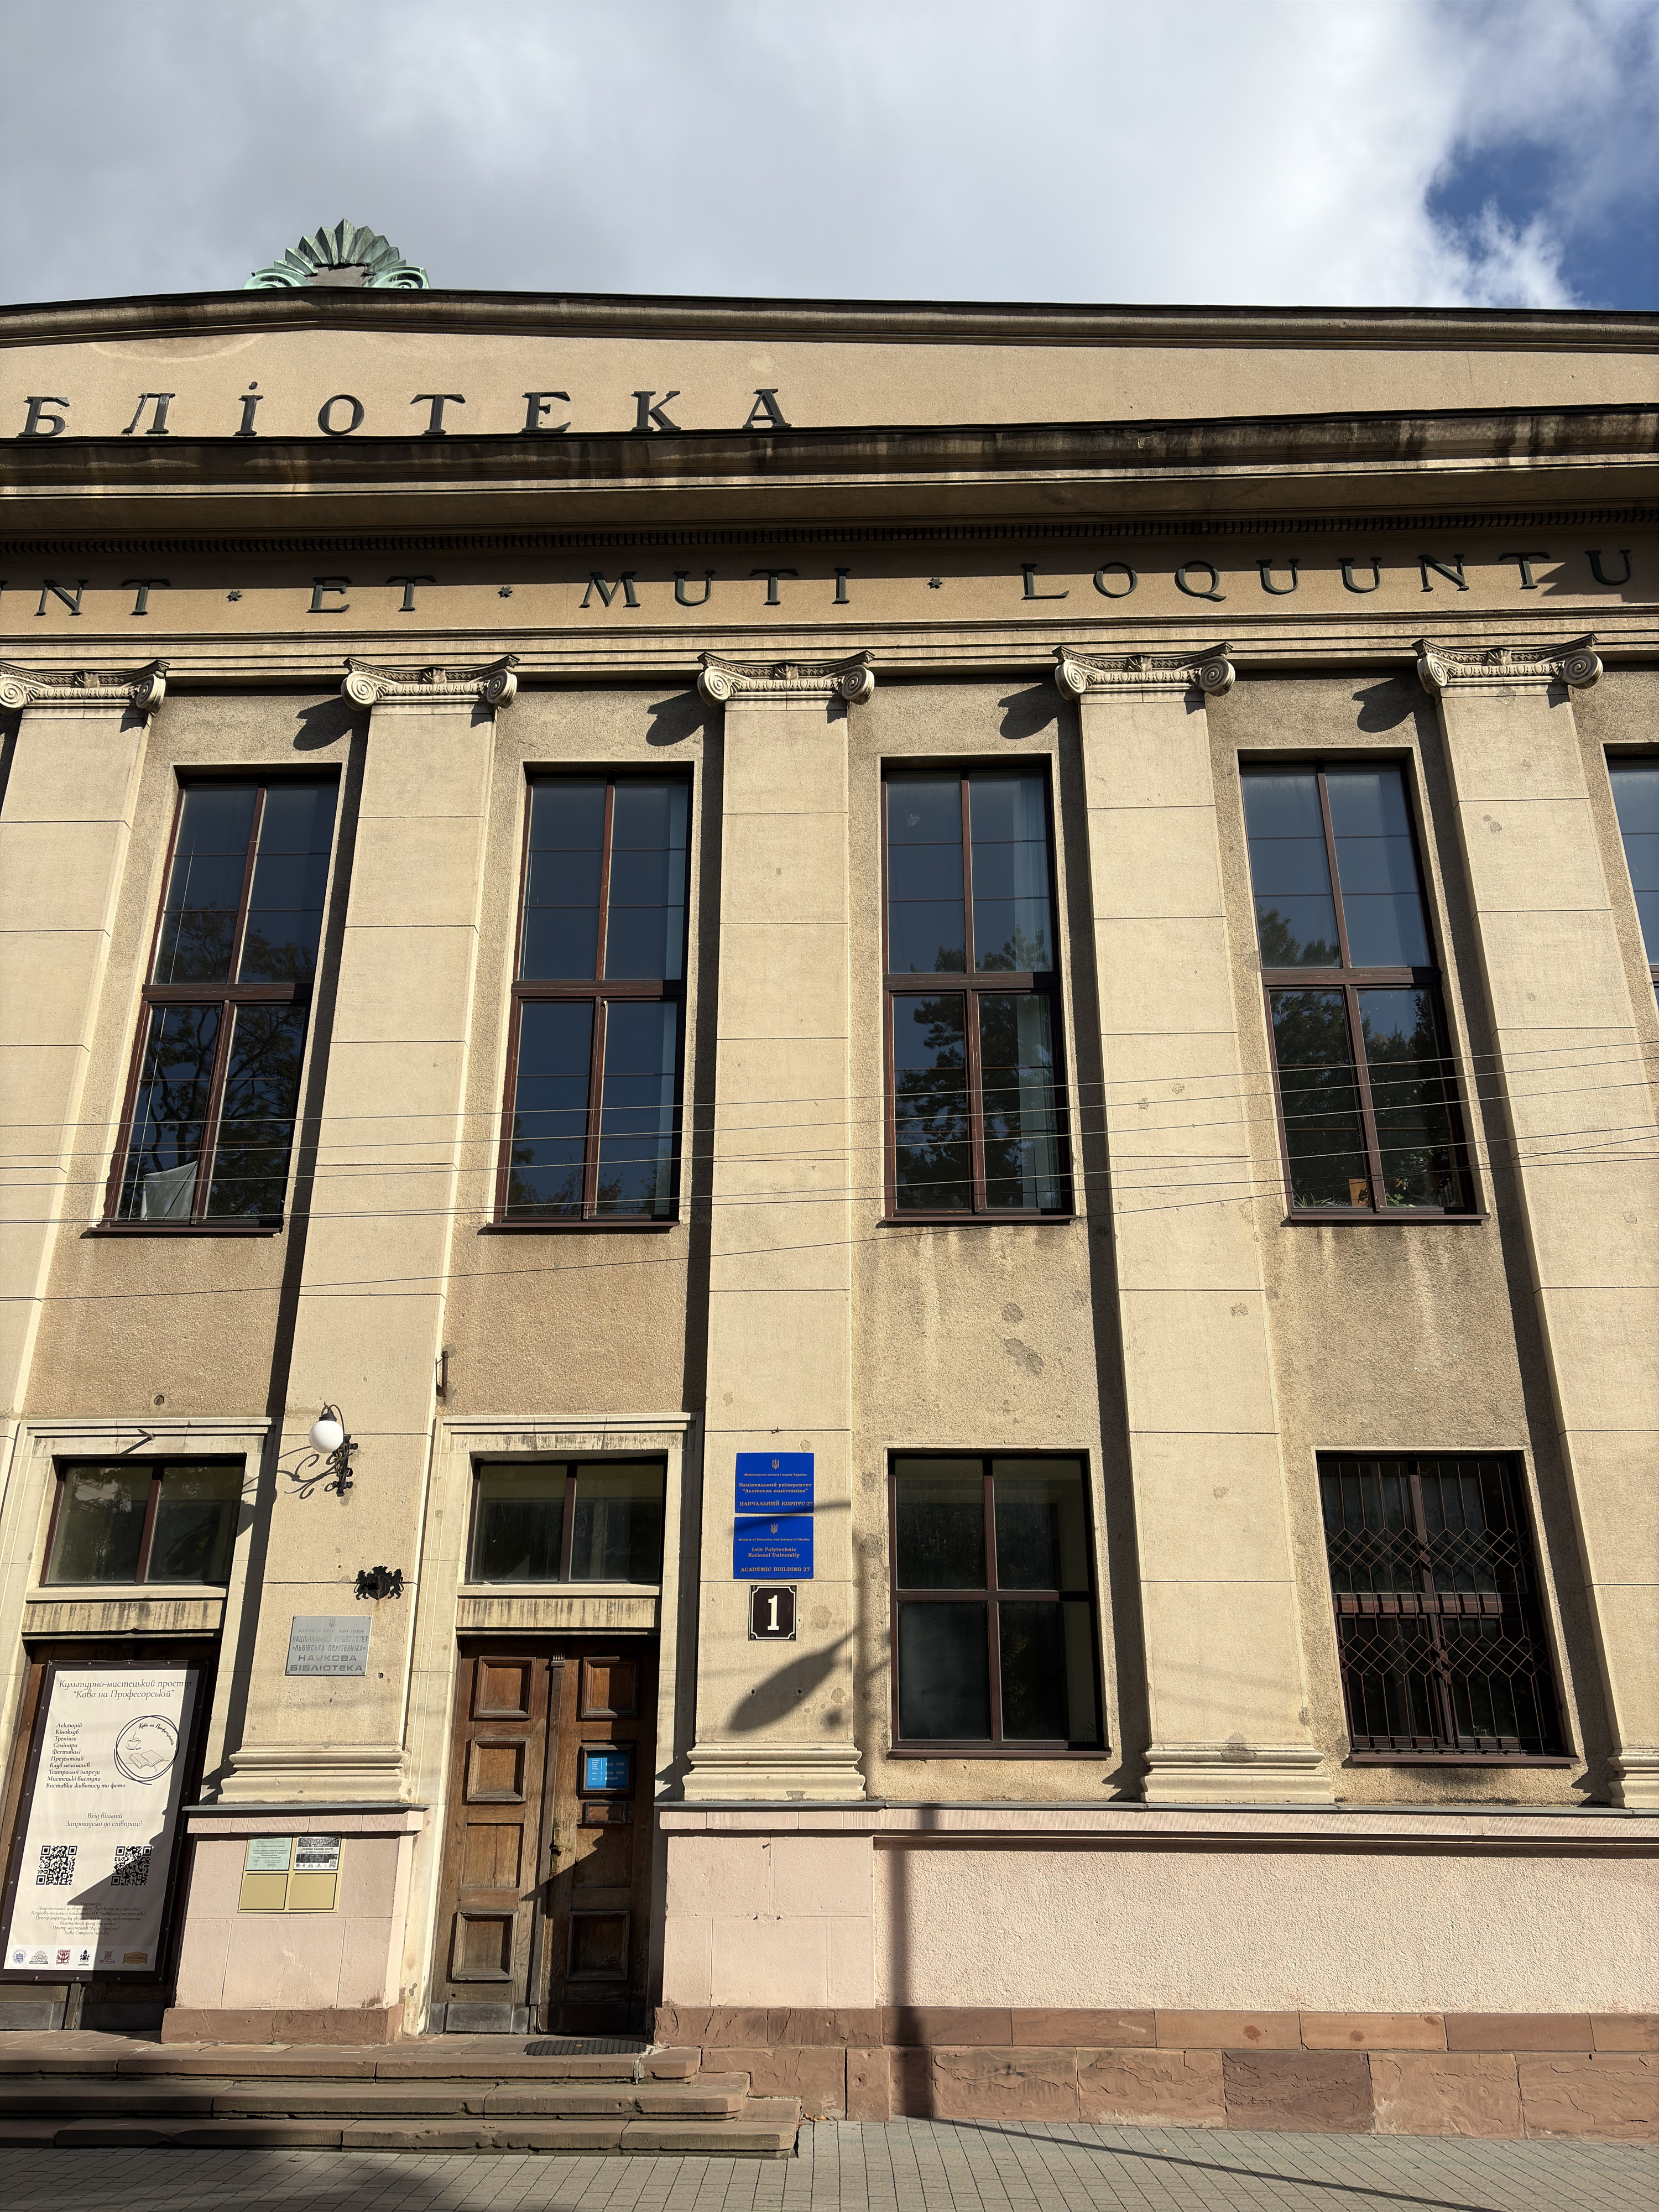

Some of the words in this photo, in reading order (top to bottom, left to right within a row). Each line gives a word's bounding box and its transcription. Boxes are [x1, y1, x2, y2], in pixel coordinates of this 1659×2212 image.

[0, 578, 171, 617] NT
[306, 575, 437, 613] ET
[578, 567, 852, 608] MUTI
[1020, 549, 1631, 602] LOQUUNTU
[767, 1595, 779, 1630] 1
[59, 1679, 155, 1691] Культурно-мистецький
[158, 1680, 192, 1690] простір
[74, 1689, 96, 1698] “Кава
[110, 1689, 175, 1700] Професорській”
[112, 1820, 142, 1828] співпраці!
